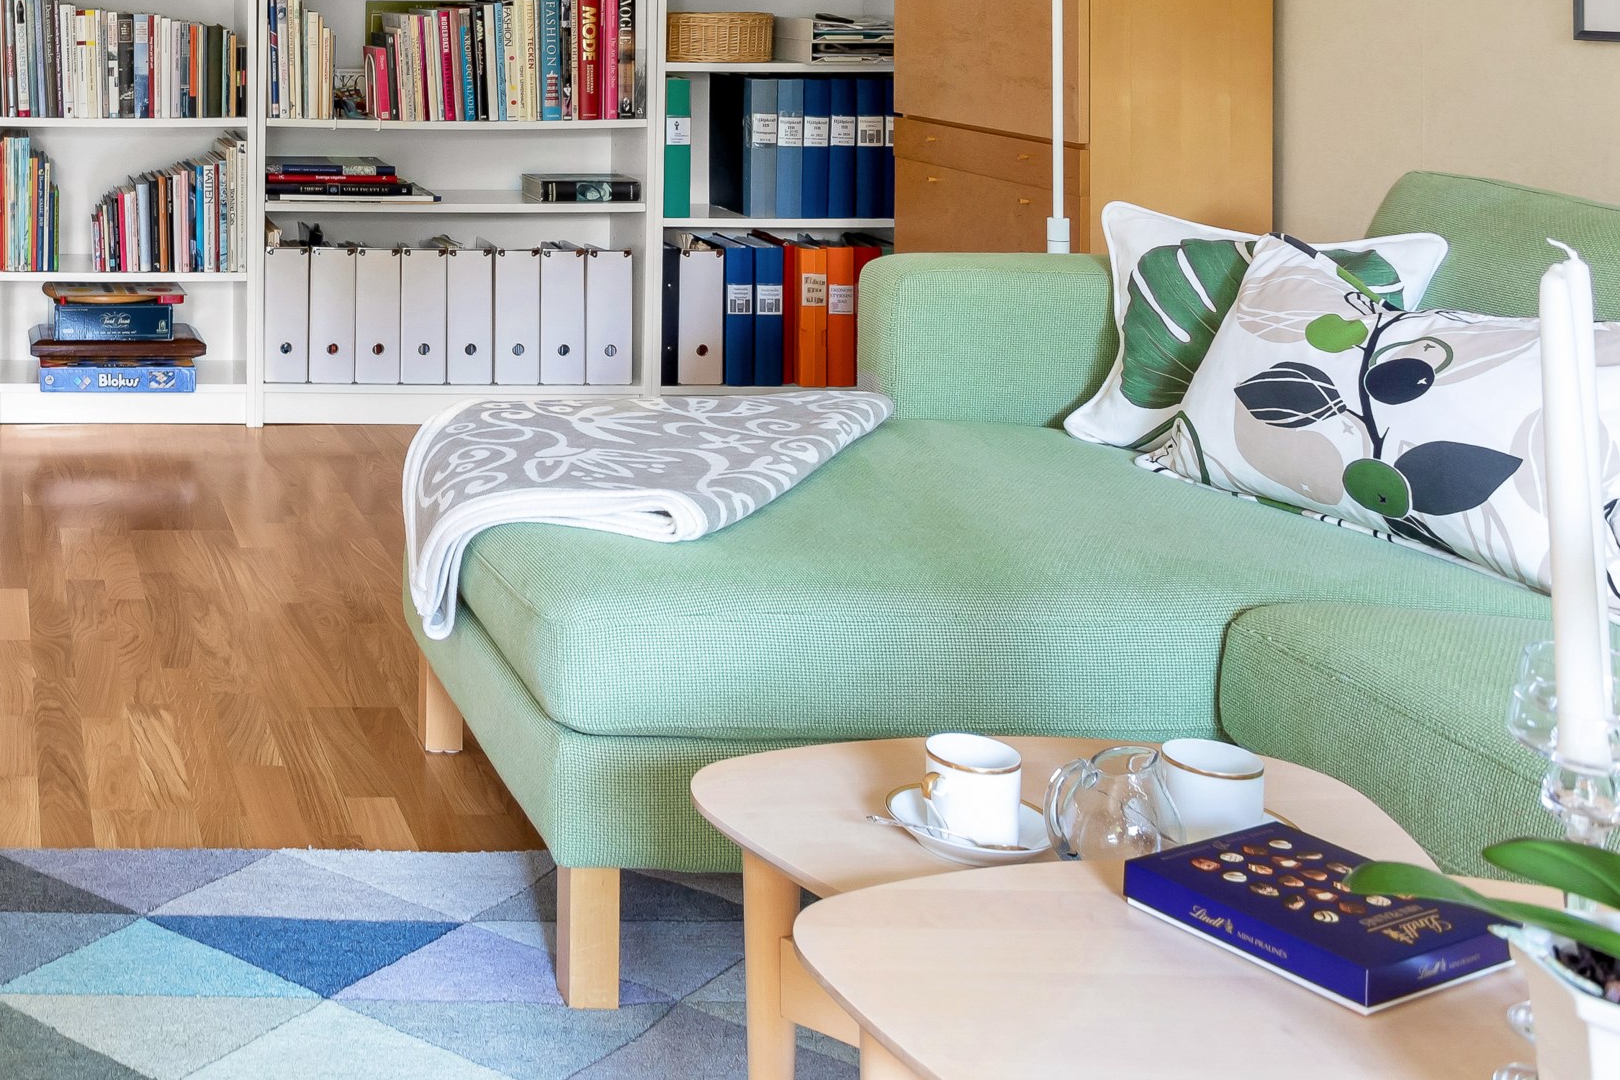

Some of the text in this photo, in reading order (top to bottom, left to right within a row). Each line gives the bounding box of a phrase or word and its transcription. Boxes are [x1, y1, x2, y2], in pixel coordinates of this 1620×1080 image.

[546, 1, 557, 67] FASHION
[582, 6, 597, 61] MODE
[619, 0, 632, 45] VOGUE
[205, 168, 214, 204] KATTEN
[98, 374, 140, 390] Blokus
[1190, 905, 1287, 960] Lindt MINI PRALINÉS
[1399, 914, 1452, 939] Lindt
